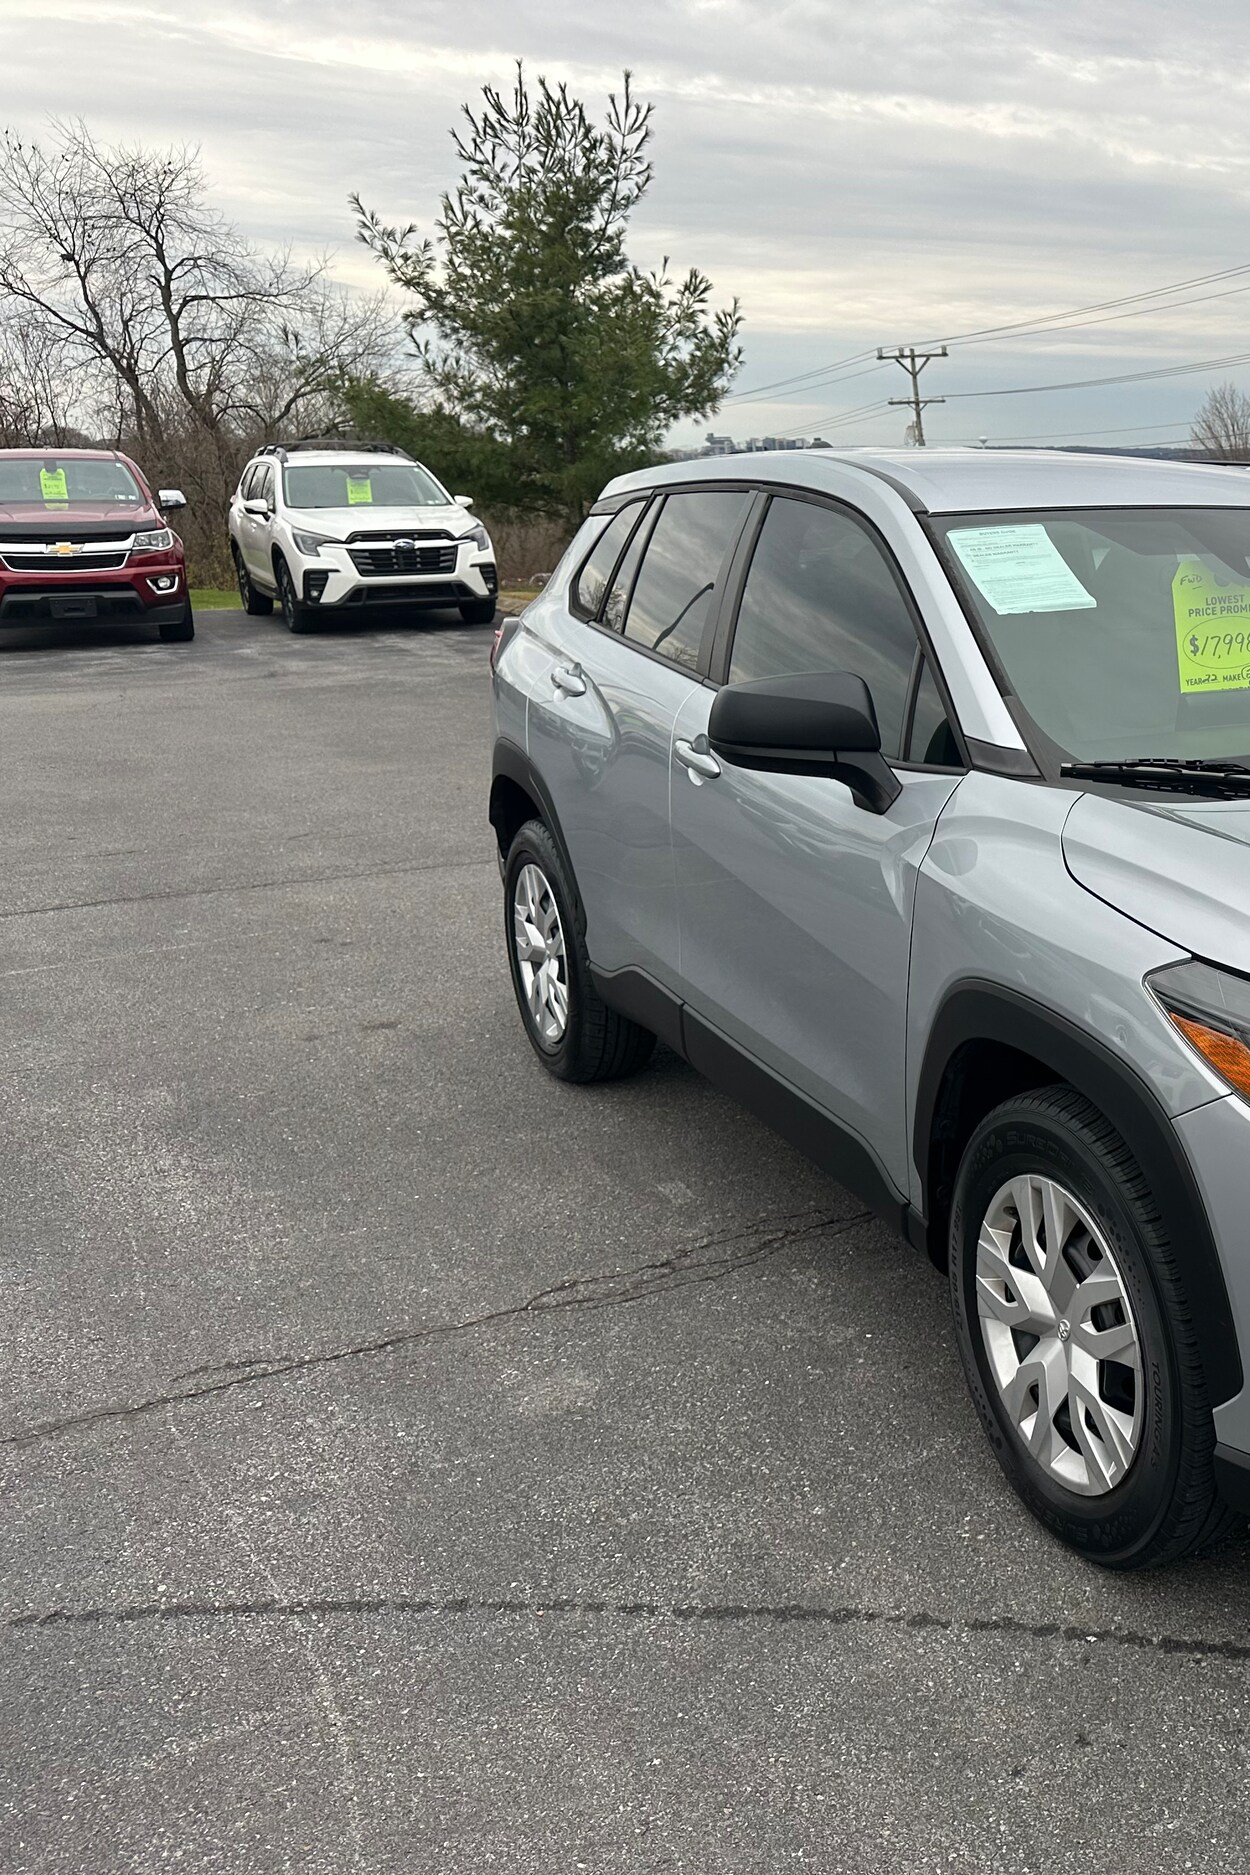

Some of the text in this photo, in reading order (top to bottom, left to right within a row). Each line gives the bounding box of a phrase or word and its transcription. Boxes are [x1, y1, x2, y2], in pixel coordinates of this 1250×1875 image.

[1180, 573, 1203, 586] FWD
[1205, 594, 1246, 606] LOWEST
[1188, 606, 1217, 618] PRICE
[1185, 677, 1203, 687] YEAR
[1222, 673, 1241, 683] MAKE
[1151, 1361, 1163, 1442] TOURING
